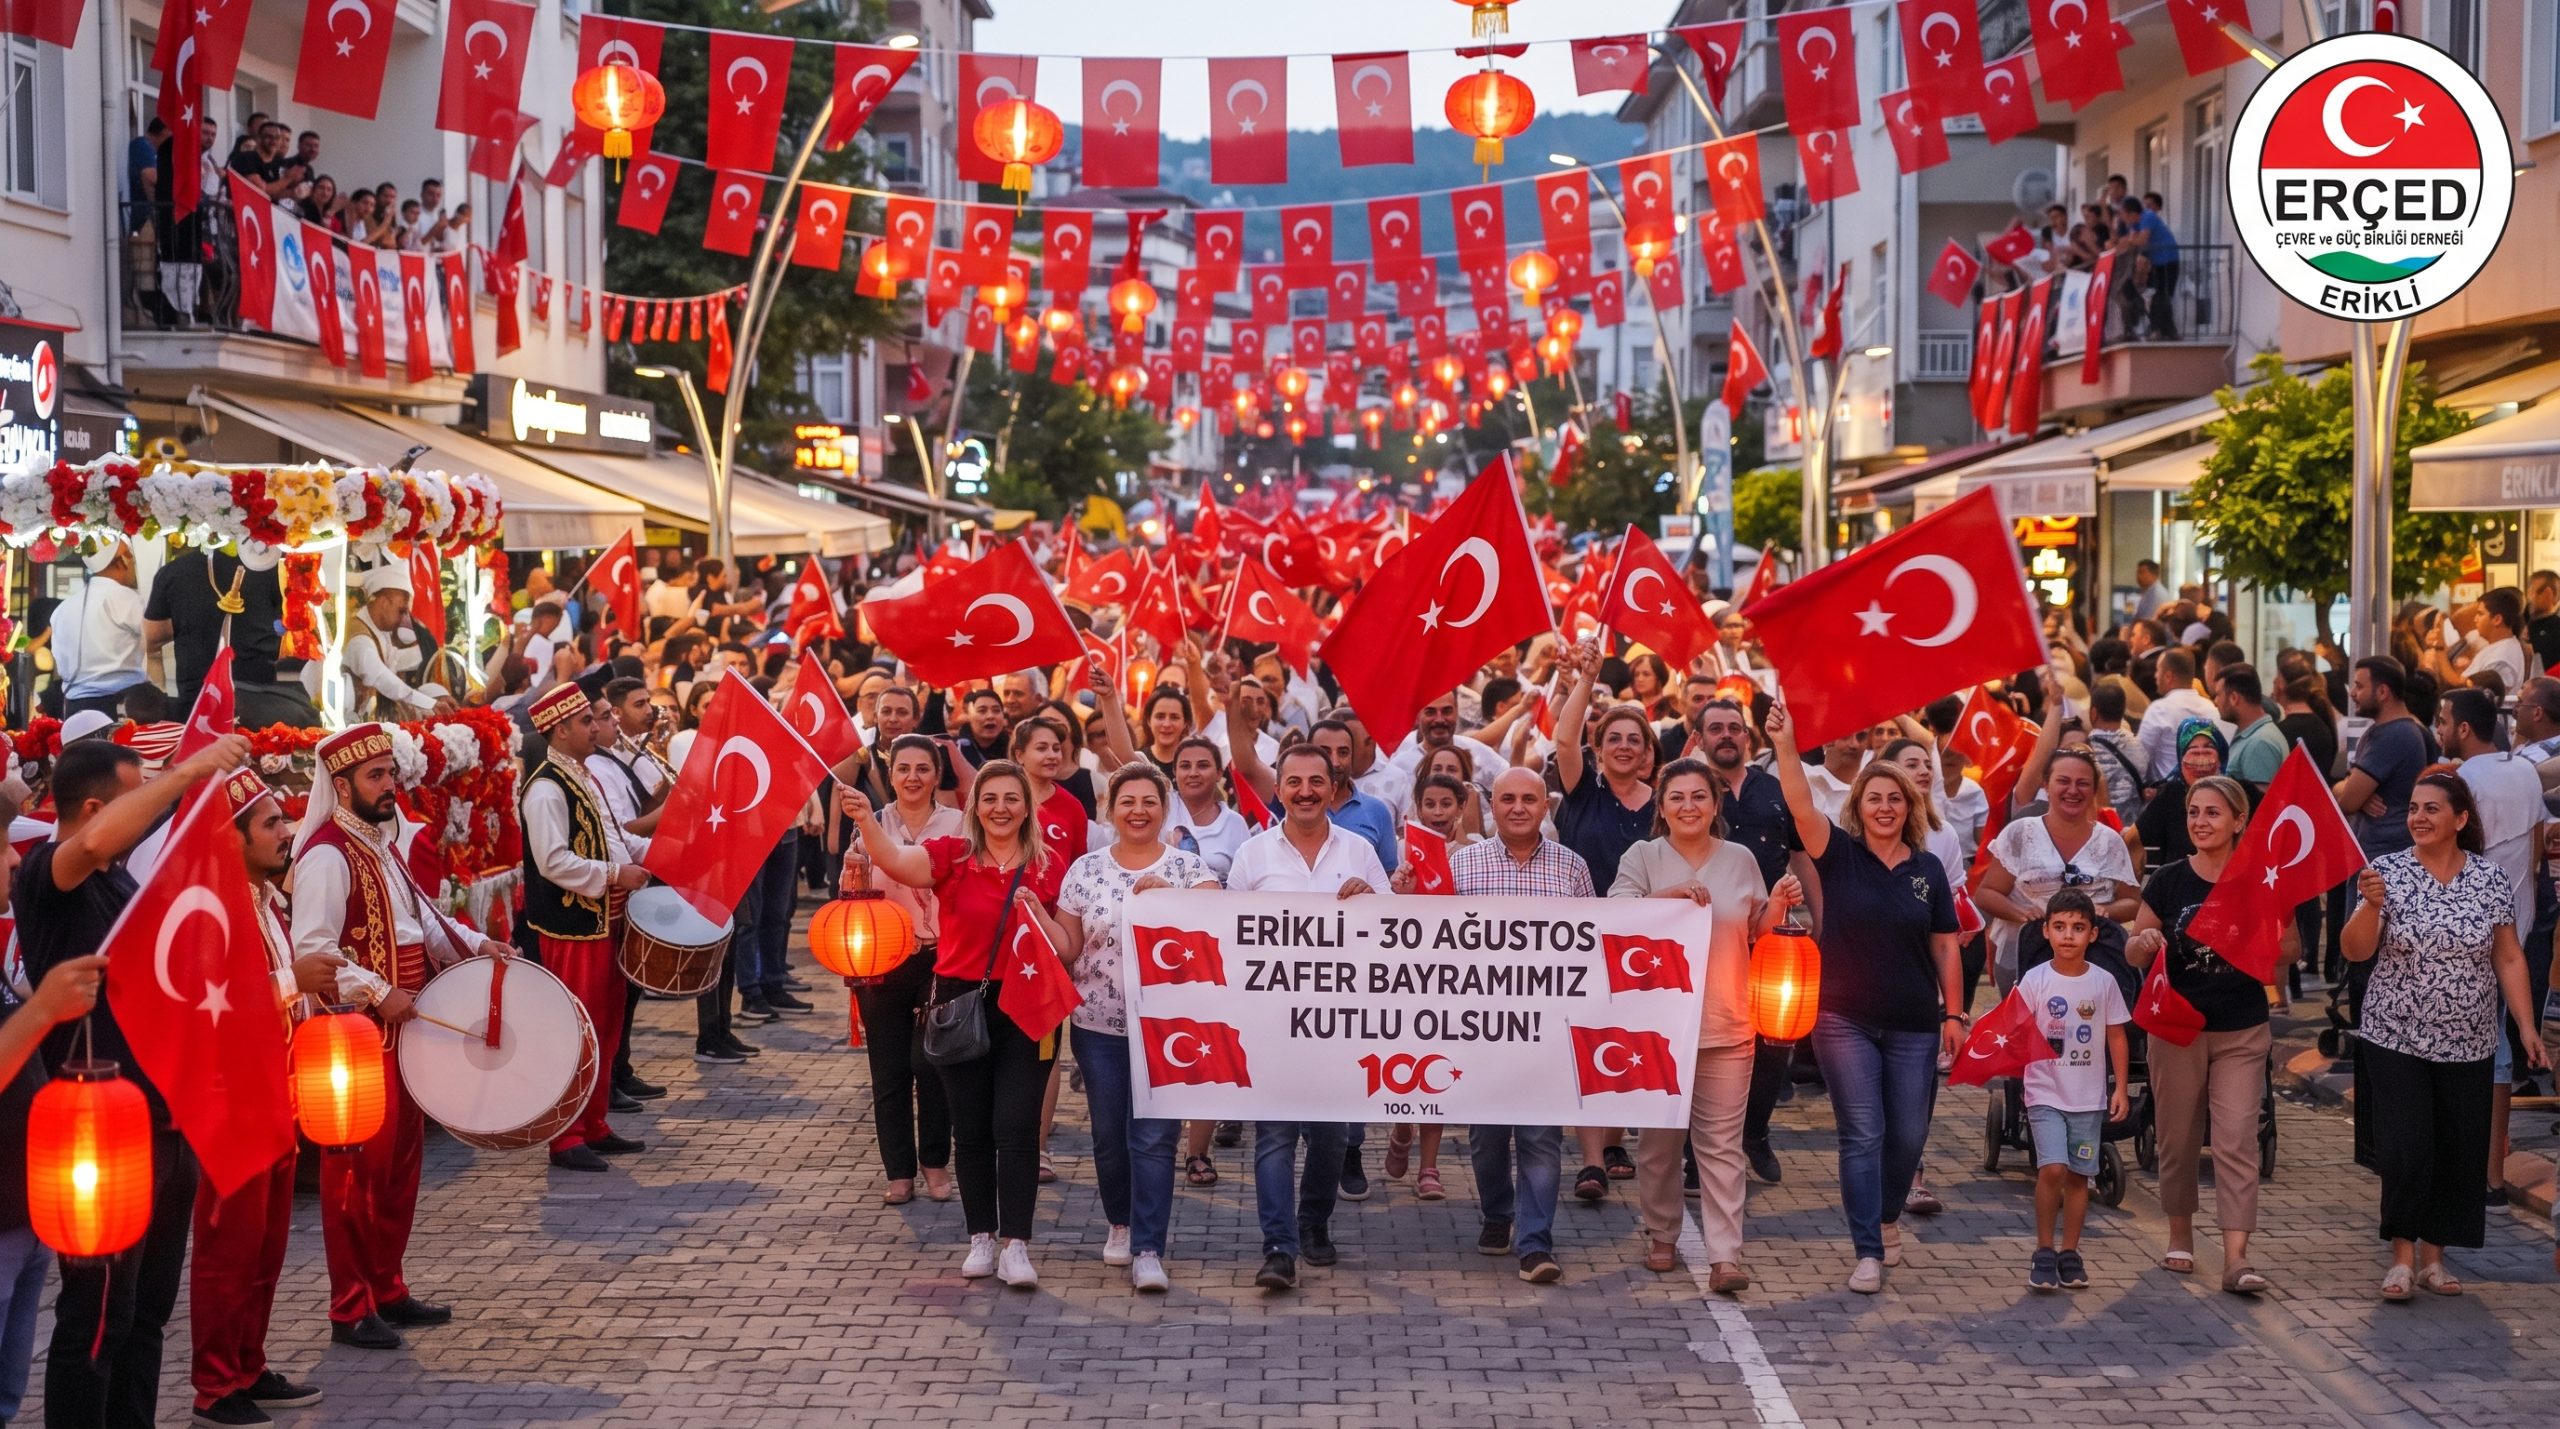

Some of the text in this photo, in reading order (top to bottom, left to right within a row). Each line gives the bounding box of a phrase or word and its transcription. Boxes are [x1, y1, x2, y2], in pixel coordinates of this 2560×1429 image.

[1237, 909, 1596, 953] ERİKLİ - 30 AĞUSTOS
[1244, 959, 1588, 997] ZAFER BAYRAMIMIZ
[1290, 1006, 1541, 1043] KUTLU OLSUN!
[1384, 1102, 1445, 1116] 100. YIL
